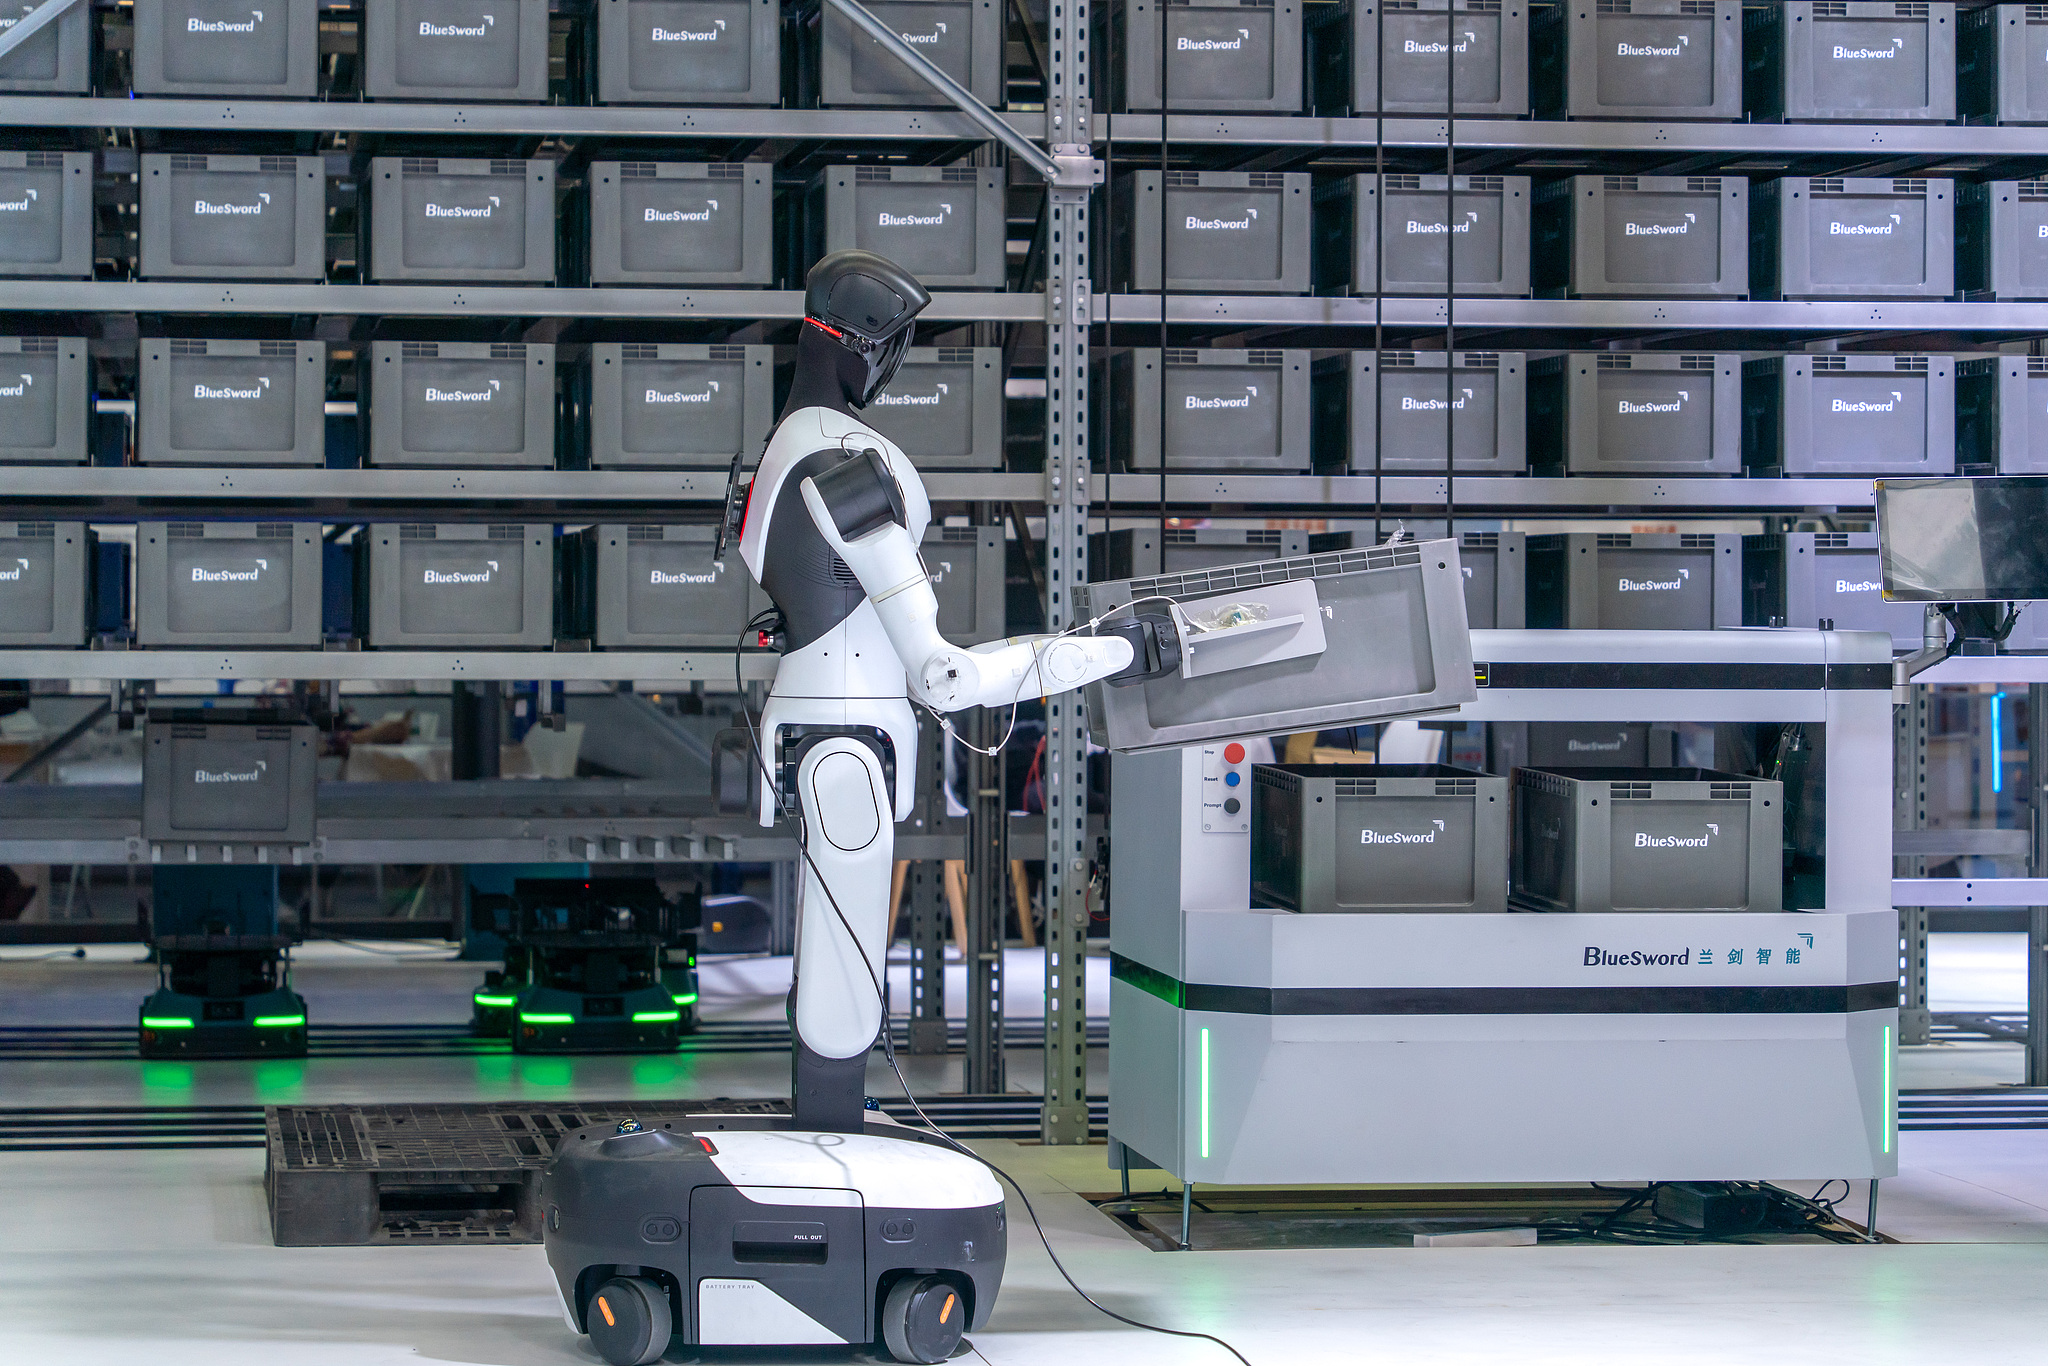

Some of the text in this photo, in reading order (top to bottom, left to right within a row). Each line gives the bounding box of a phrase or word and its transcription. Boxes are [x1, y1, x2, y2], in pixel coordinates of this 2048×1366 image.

[188, 18, 254, 32] BlueSword
[420, 21, 485, 36] BlueSword
[652, 28, 717, 42] BlueSword
[1177, 37, 1241, 51] BlueSword
[1618, 43, 1680, 57] BlueSword
[1833, 46, 1894, 60] BlueSword
[195, 200, 261, 214] BlueSword
[426, 203, 491, 217] BlueSword
[645, 208, 709, 222] BlueSword
[879, 213, 943, 227] BlueSword
[1186, 216, 1249, 230] BlueSword
[1626, 221, 1688, 235] BlueSword
[1830, 222, 1892, 235] BlueSword
[194, 385, 261, 399] BlueSword
[426, 388, 491, 402] BlueSword
[646, 390, 710, 404] BlueSword
[875, 393, 939, 405] BlueSword
[1186, 395, 1249, 409] BlueSword
[1402, 397, 1465, 410] BlueSwrd
[1619, 400, 1681, 413] BlueSword
[1832, 398, 1894, 412] BlueSword
[192, 568, 258, 582] BlueSword
[424, 570, 490, 584] BlueSword
[651, 570, 716, 584] BlueSword
[1619, 577, 1681, 591] BlueSword
[194, 769, 258, 783] BlueSword
[1361, 829, 1434, 844] BlueSword
[1635, 833, 1708, 848] BlueSword
[1584, 946, 1801, 966] BlueSword 兰剑智能
